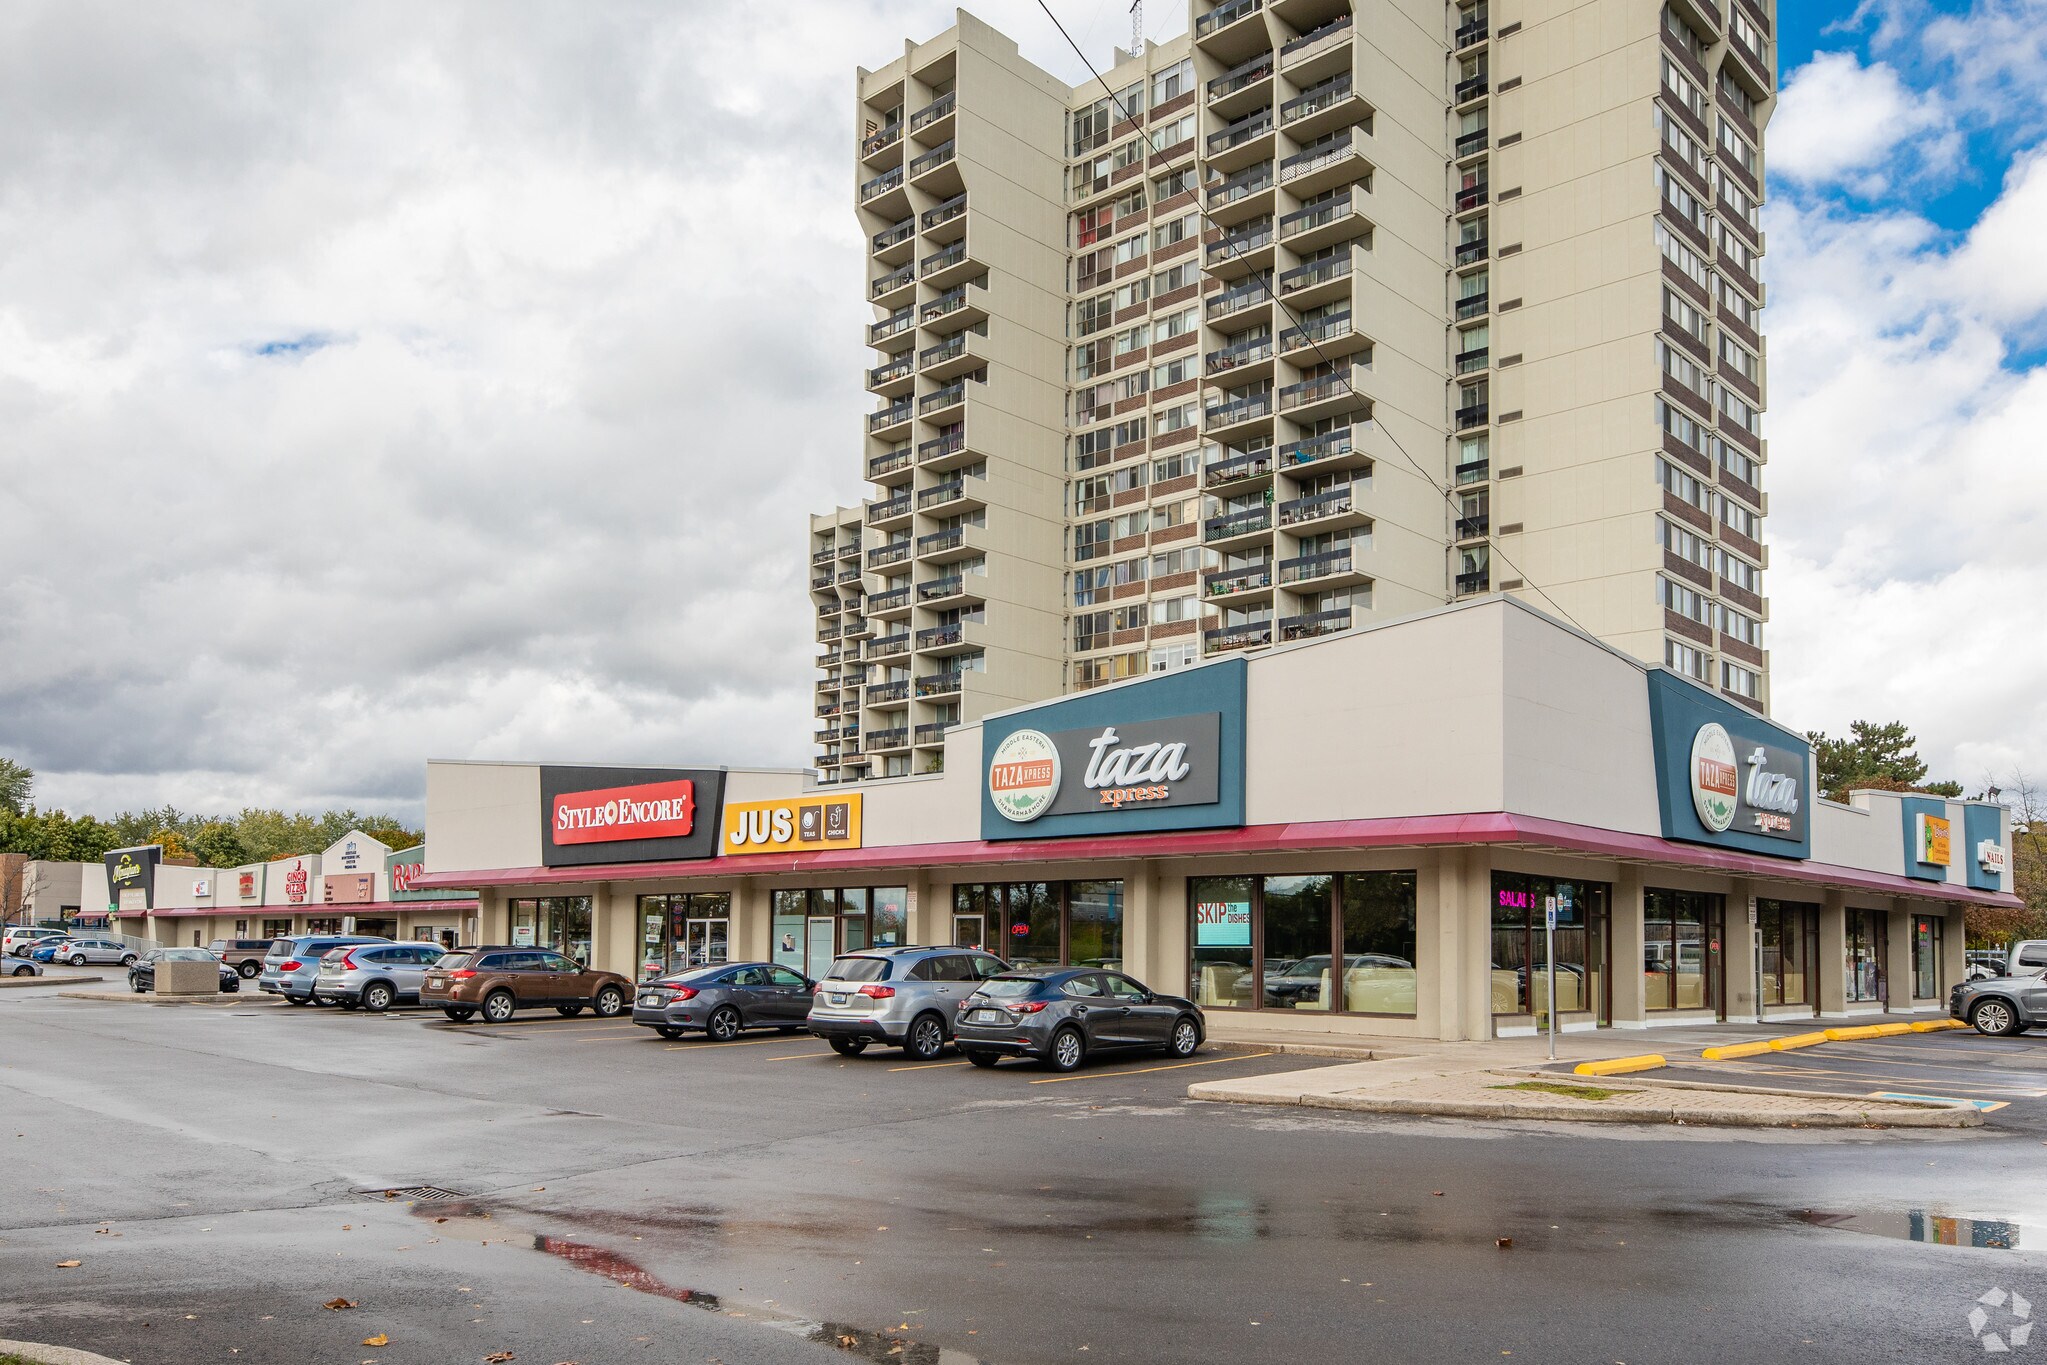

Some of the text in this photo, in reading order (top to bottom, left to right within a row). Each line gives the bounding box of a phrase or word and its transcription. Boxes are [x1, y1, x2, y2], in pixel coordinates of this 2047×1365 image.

[1001, 736, 1020, 754] MIDDLE
[1022, 734, 1046, 750] EASTERN
[1084, 727, 1190, 789] taza
[995, 765, 1051, 788] TAZA XPRESS
[1701, 761, 1720, 789] TAZA
[1746, 747, 1799, 815] taza
[1100, 784, 1169, 808] xpress
[557, 798, 683, 830] STYLE ENCORE
[730, 807, 794, 845] JUS
[803, 829, 845, 838] TEAS CHICKS
[1986, 851, 2004, 865] NAILS
[1197, 902, 1238, 924] SKIP the
[1227, 913, 1250, 924] DISHES
[1011, 925, 1029, 935] OPEN
